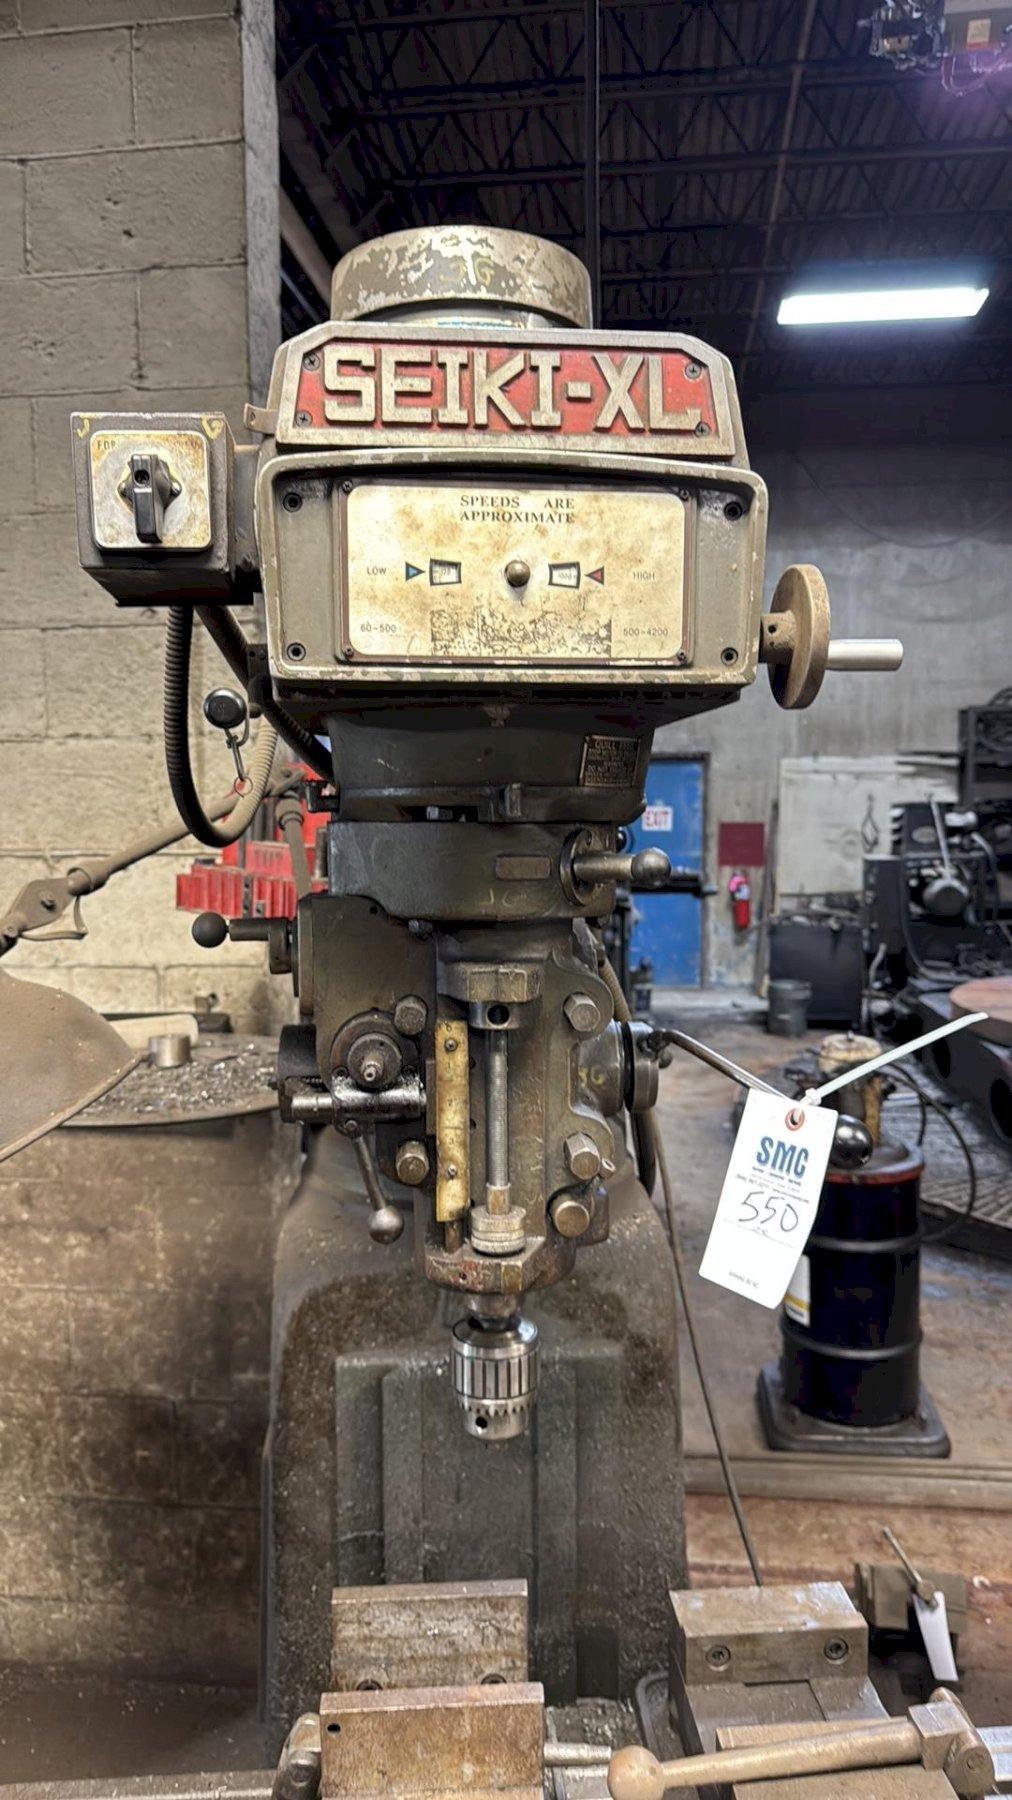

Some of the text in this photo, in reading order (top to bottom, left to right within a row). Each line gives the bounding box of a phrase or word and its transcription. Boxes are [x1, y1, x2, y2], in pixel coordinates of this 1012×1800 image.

[324, 344, 701, 432] SEIKI-XL
[460, 495, 575, 510] SPEEDS ARE
[460, 510, 575, 525] APPROXIMATE
[366, 566, 387, 576] LOW
[632, 571, 656, 582] HIGH
[756, 1135, 809, 1179] SMC
[737, 1190, 799, 1232] 550
